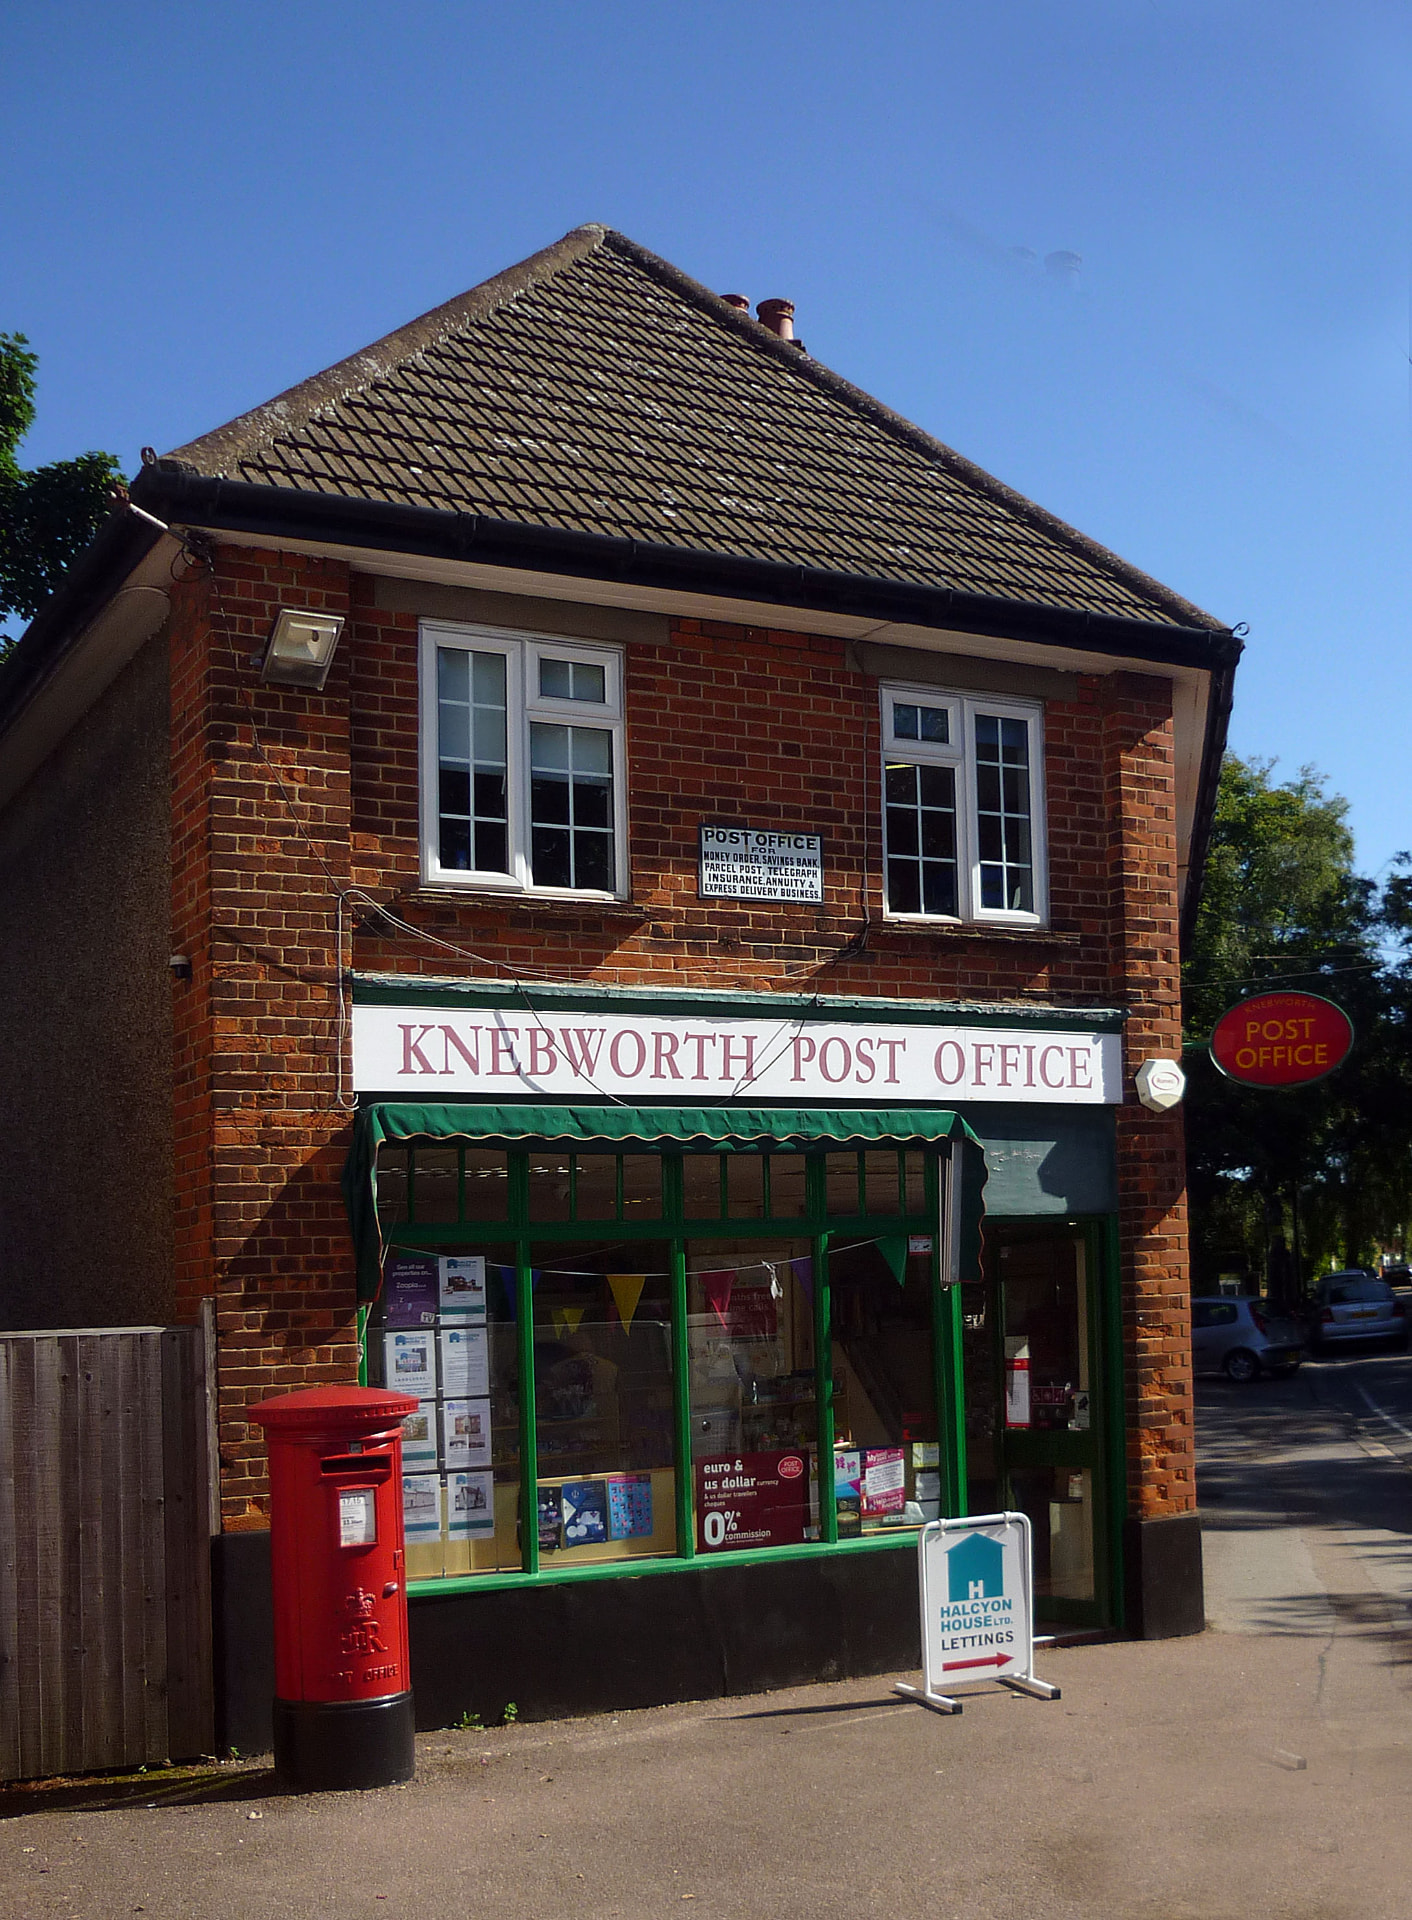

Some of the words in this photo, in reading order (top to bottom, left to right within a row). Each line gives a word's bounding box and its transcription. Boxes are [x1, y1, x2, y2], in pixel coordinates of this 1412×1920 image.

[704, 830, 751, 845] POST
[755, 834, 817, 850] OFFICE
[704, 851, 729, 862] MONEY
[763, 855, 794, 866] SAVINGS
[705, 863, 736, 873] PARCEL
[768, 867, 818, 878] TELEGRAPH
[705, 883, 737, 893] EXPRESS
[740, 886, 778, 897] DELIVERY
[766, 877, 806, 888] ANNUITY
[1244, 997, 1316, 1012] KNEBWORTH
[1246, 1018, 1316, 1042] POST
[397, 1023, 758, 1081] KNEBWORTH
[790, 1036, 906, 1083] POST
[934, 1040, 1093, 1089] OFFICE
[1235, 1044, 1328, 1069] OFFICE
[704, 1462, 730, 1474] euro
[734, 1459, 743, 1472] &
[704, 1480, 718, 1490] us
[722, 1476, 756, 1488] dollar
[724, 1529, 771, 1541] commission
[968, 1579, 984, 1599] H
[940, 1599, 1012, 1618] HALCYON
[941, 1615, 993, 1632] HOUSE
[994, 1617, 1013, 1626] LTD.
[942, 1630, 1014, 1650] LETTINGS
